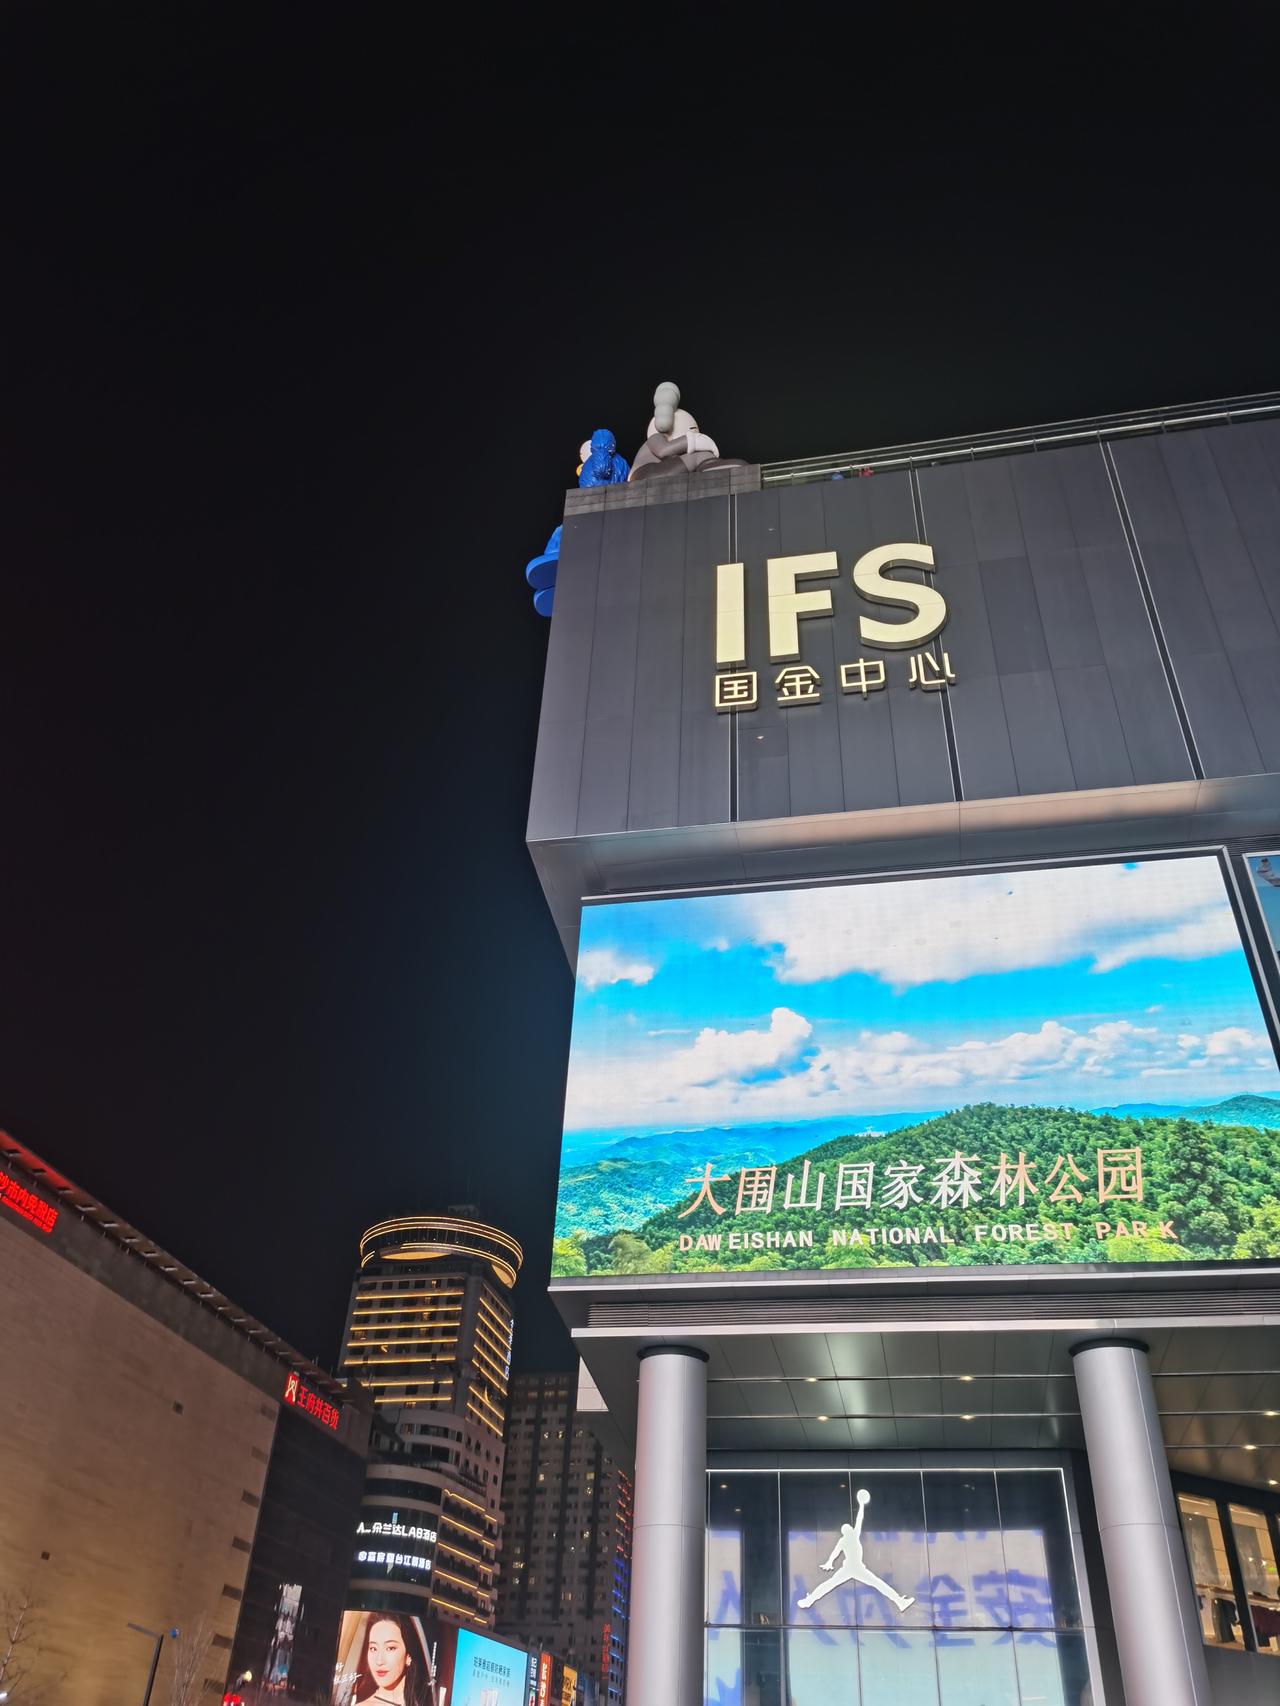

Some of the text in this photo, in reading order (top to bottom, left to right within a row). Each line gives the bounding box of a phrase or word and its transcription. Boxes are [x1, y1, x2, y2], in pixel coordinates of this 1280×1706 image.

[716, 543, 948, 668] IFS
[714, 652, 956, 713] 国金中心
[678, 1146, 1144, 1219] 大围山国家森林公园
[832, 1225, 955, 1246] NATIONAL
[974, 1222, 1074, 1244] FOREST
[297, 1385, 339, 1430] 王府井百货
